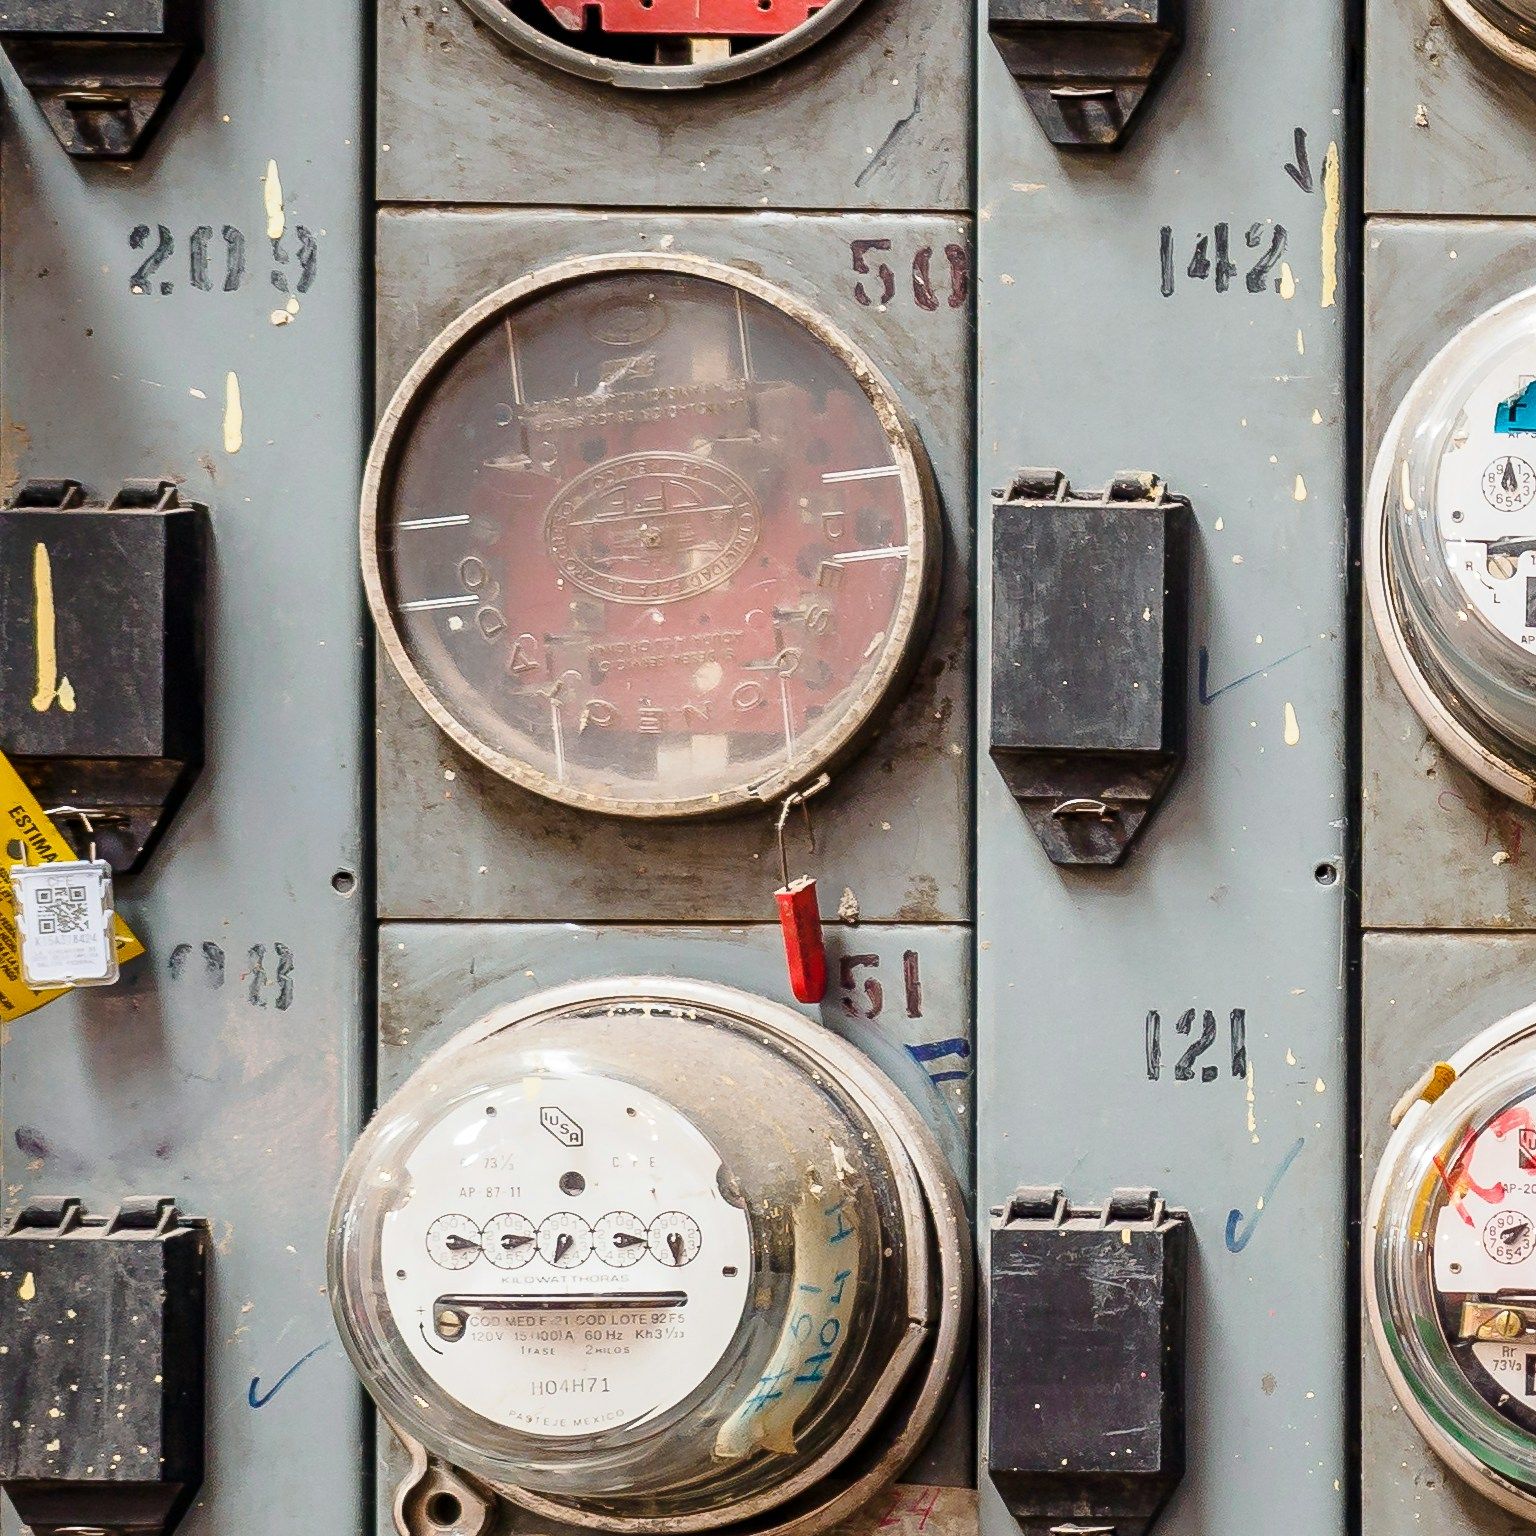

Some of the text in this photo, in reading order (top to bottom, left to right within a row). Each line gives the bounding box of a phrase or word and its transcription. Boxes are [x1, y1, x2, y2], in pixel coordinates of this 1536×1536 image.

[129, 224, 317, 295] 209
[850, 239, 968, 311] 50
[1160, 223, 1288, 297] 142
[840, 950, 922, 1019] 51
[1146, 1008, 1246, 1082] 121
[543, 1112, 580, 1143] IUSA
